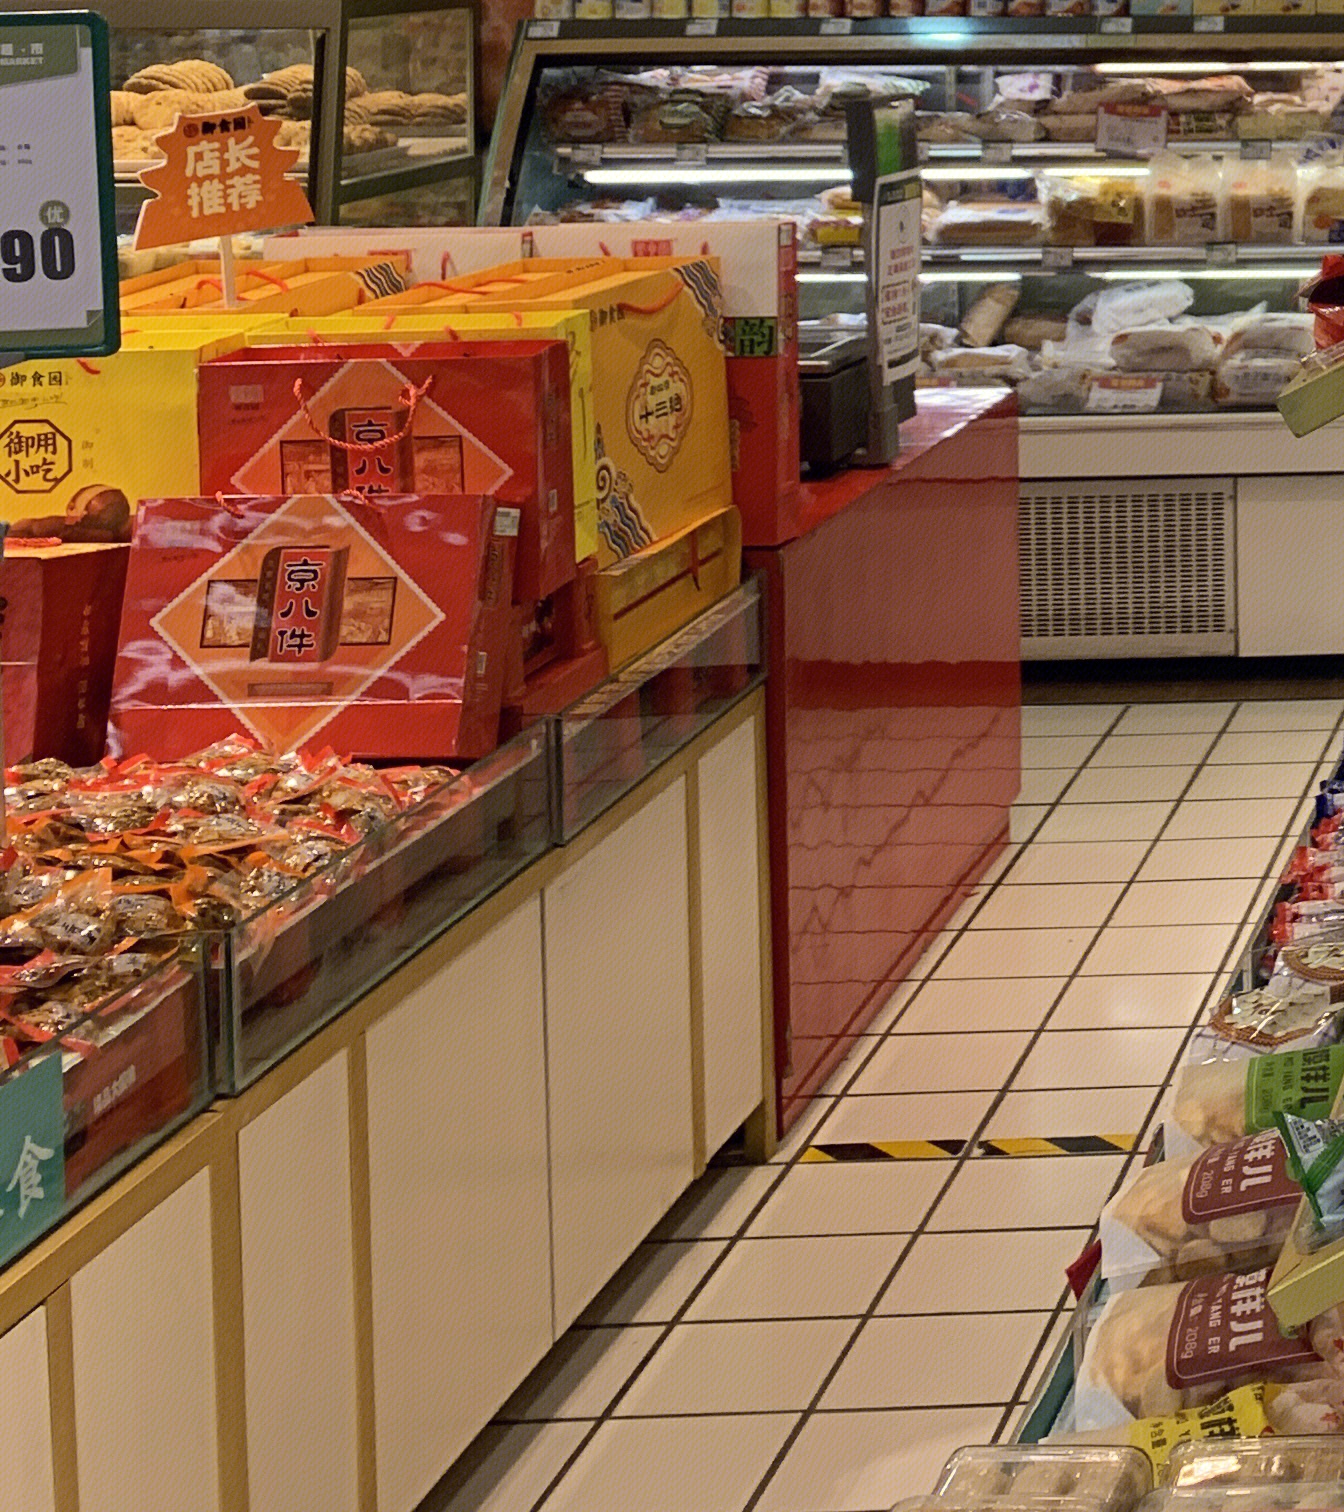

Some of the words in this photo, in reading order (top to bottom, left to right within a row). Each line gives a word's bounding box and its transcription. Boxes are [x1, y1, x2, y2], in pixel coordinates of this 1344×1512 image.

[185, 136, 260, 179] 店长
[187, 174, 264, 218] 推荐
[1, 227, 75, 283] 90
[10, 370, 63, 387] 御食园
[3, 430, 57, 458] 御用
[5, 457, 60, 485] 小吃
[276, 556, 326, 656] 京八件
[1195, 1169, 1214, 1200] 208g
[1219, 1178, 1234, 1195] ER
[1180, 1326, 1200, 1361] 208g
[1206, 1336, 1221, 1356] ER
